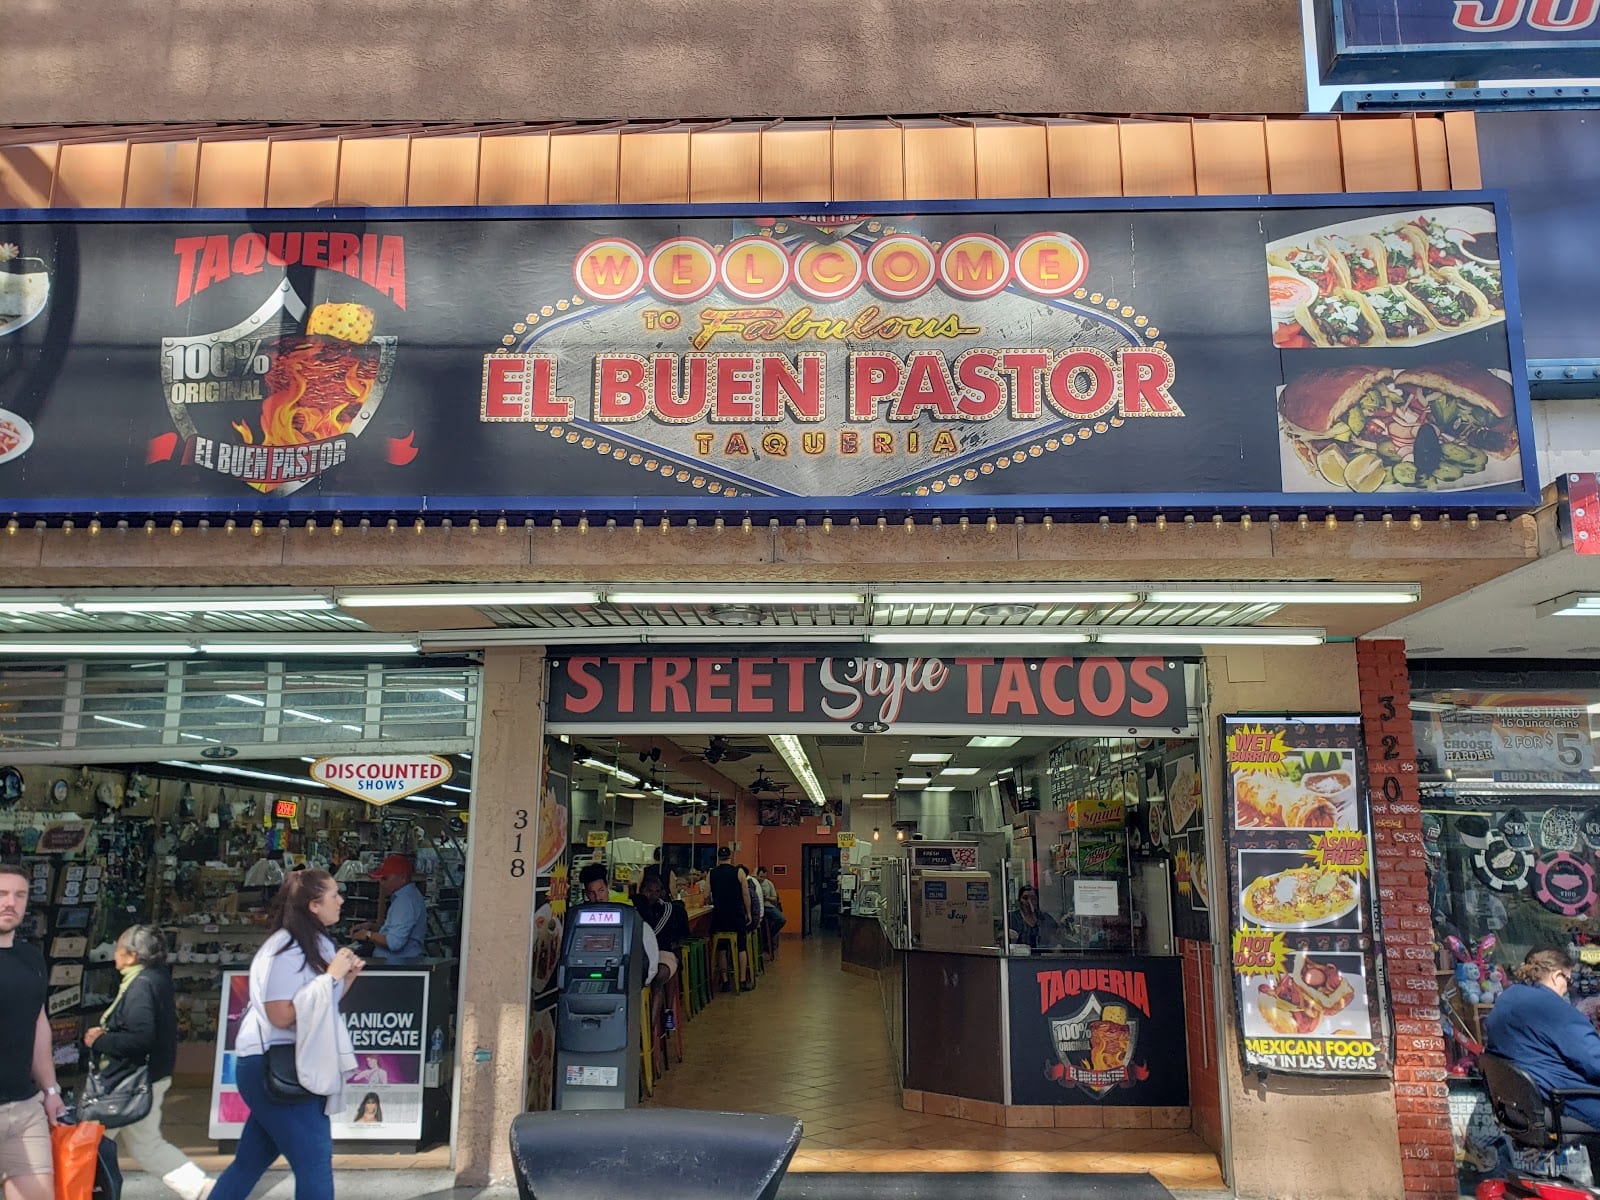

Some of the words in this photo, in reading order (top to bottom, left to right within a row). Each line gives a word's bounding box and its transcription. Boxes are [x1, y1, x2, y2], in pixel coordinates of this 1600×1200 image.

[174, 231, 407, 312] TAQUERIA
[643, 310, 680, 330] TO
[693, 306, 981, 351] Fabulous
[164, 338, 270, 380] 100%
[171, 380, 263, 405] ORIGINAL
[480, 352, 576, 423] EL
[593, 351, 827, 424] BUEN
[849, 347, 1186, 422] PASTOR
[695, 430, 960, 456] TAQUERIA
[194, 436, 214, 470] EL
[217, 442, 268, 480] BUEN
[270, 439, 348, 480] PASTOR
[564, 656, 818, 714] STREET
[818, 656, 950, 723] Style
[954, 656, 1170, 718] TACOS
[1545, 706, 1581, 719] HARD
[1501, 718, 1513, 729] 16
[1516, 718, 1550, 728] Ounce
[1553, 718, 1579, 728] Cans
[1235, 733, 1275, 752] WET
[1444, 740, 1493, 750] CHOOSE
[1503, 737, 1513, 749] 2
[1516, 736, 1544, 749] FOR
[1229, 750, 1280, 762] BURRITO
[1444, 750, 1495, 762] HARDER
[325, 763, 442, 779] DISCOUNTED
[1501, 771, 1528, 783] BUD
[358, 780, 405, 790] SHOWS
[1316, 836, 1367, 851] ASADA
[1322, 850, 1364, 865] FRIES
[589, 913, 614, 922] ATM
[1239, 936, 1274, 952] HOT
[1234, 952, 1276, 967] DOGS
[1037, 968, 1151, 1019] TAQUERIA
[350, 1030, 419, 1046] ESTGATE
[1054, 1022, 1092, 1041] 100%
[1245, 1039, 1322, 1056] MEXICAN
[1280, 1056, 1296, 1068] IN
[1300, 1056, 1326, 1068] LAS
[1326, 1055, 1377, 1070] VEGAS
[1449, 1103, 1493, 1113] BEERS
